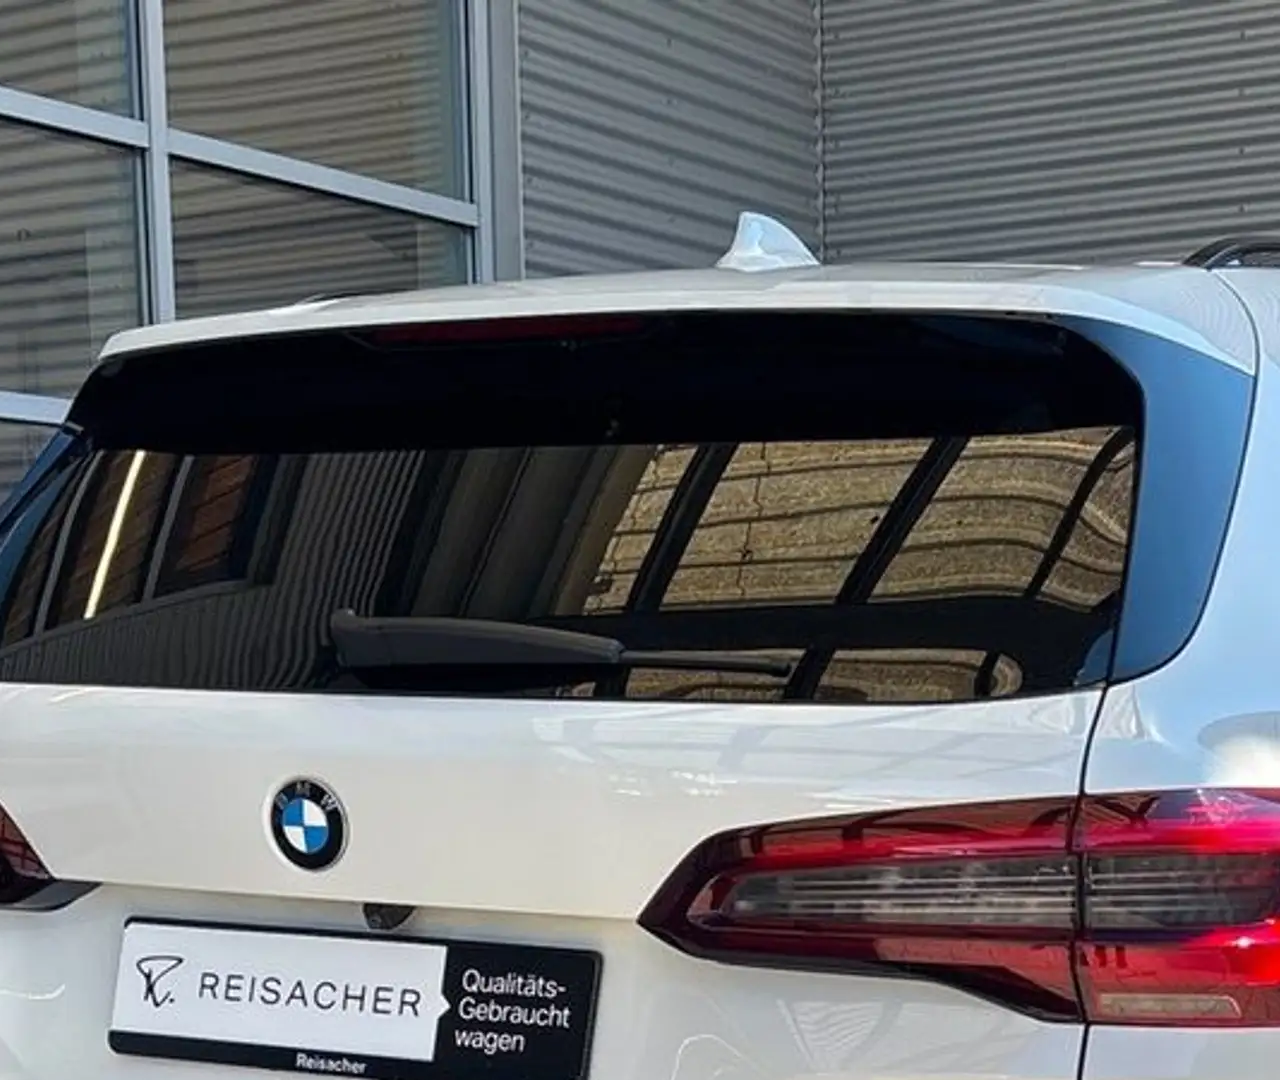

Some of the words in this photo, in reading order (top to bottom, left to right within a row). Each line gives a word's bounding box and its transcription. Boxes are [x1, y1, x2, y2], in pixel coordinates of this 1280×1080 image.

[198, 972, 422, 1017] REISACHER
[461, 968, 567, 999] Qualitäts-
[458, 996, 571, 1028] Gebraucht
[454, 1029, 525, 1055] wagen
[295, 1052, 367, 1074] Reisacher
